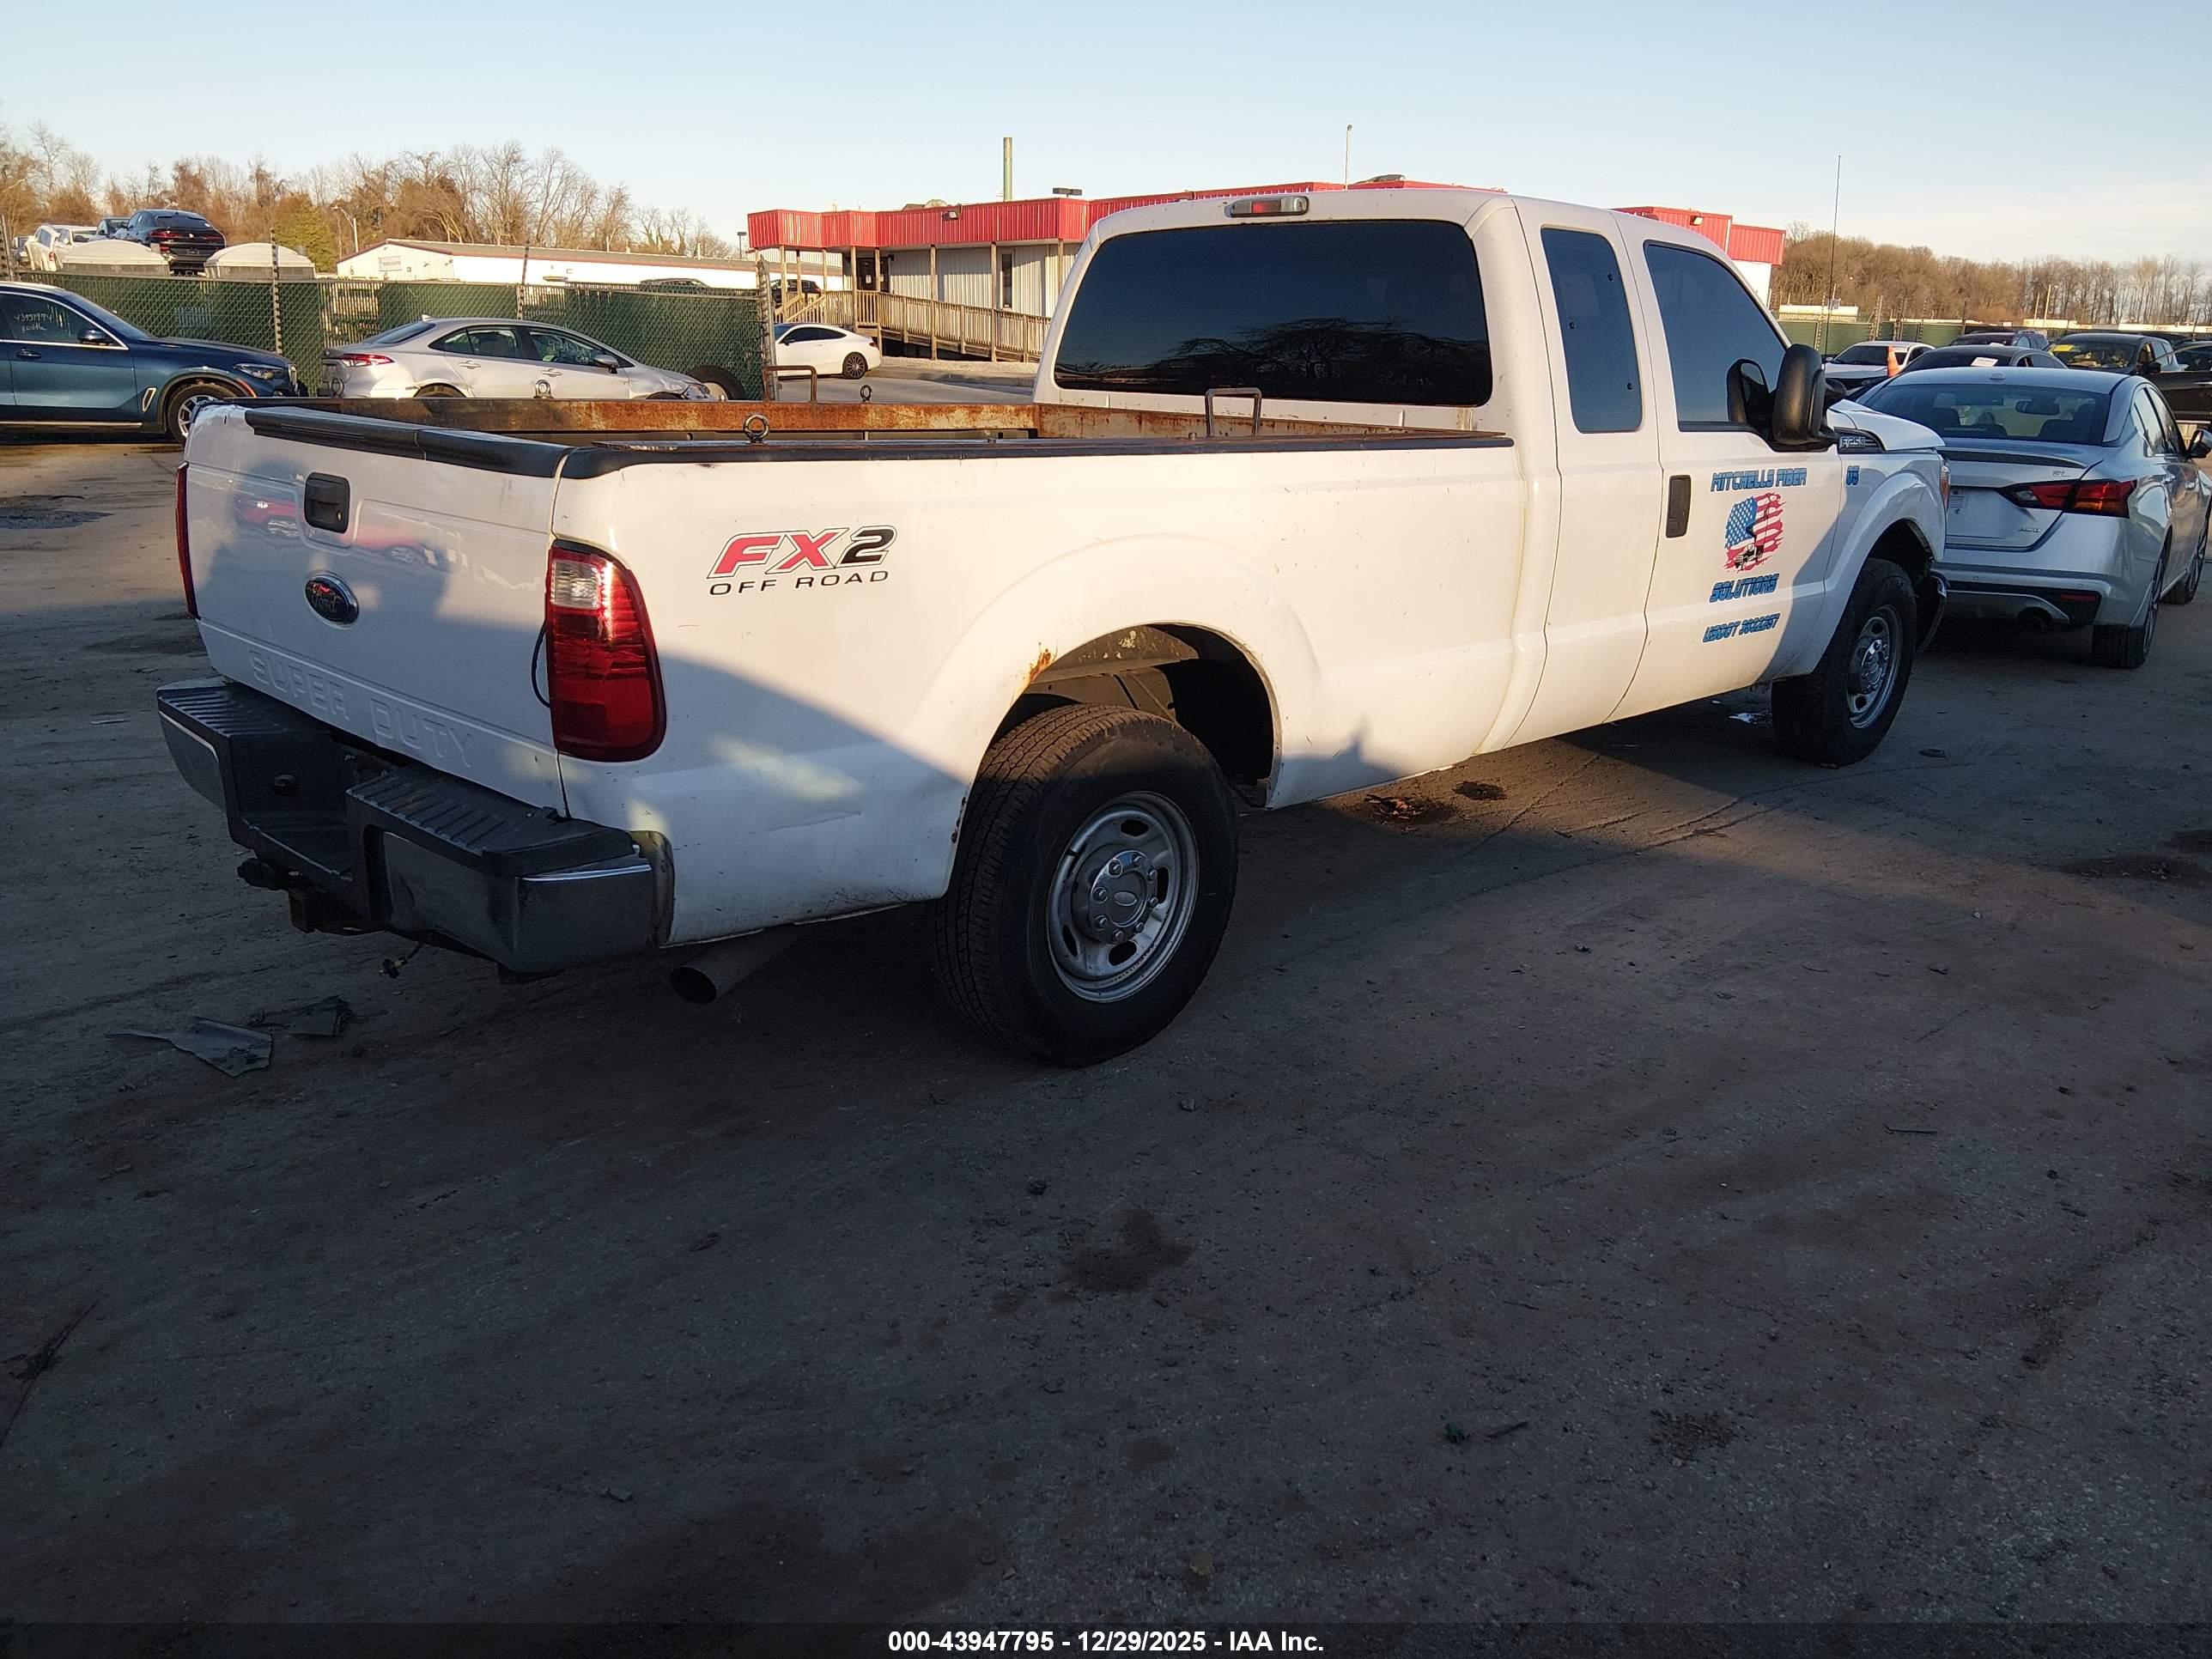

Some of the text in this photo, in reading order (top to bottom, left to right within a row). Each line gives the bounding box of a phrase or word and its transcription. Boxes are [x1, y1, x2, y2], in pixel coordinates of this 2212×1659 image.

[1711, 469, 1775, 492] MITCHELLS
[707, 526, 897, 579] FX2
[709, 571, 889, 596] OFF ROAD
[1709, 573, 1780, 603] SOLUTIONS
[249, 650, 472, 768] SUPER DUTY
